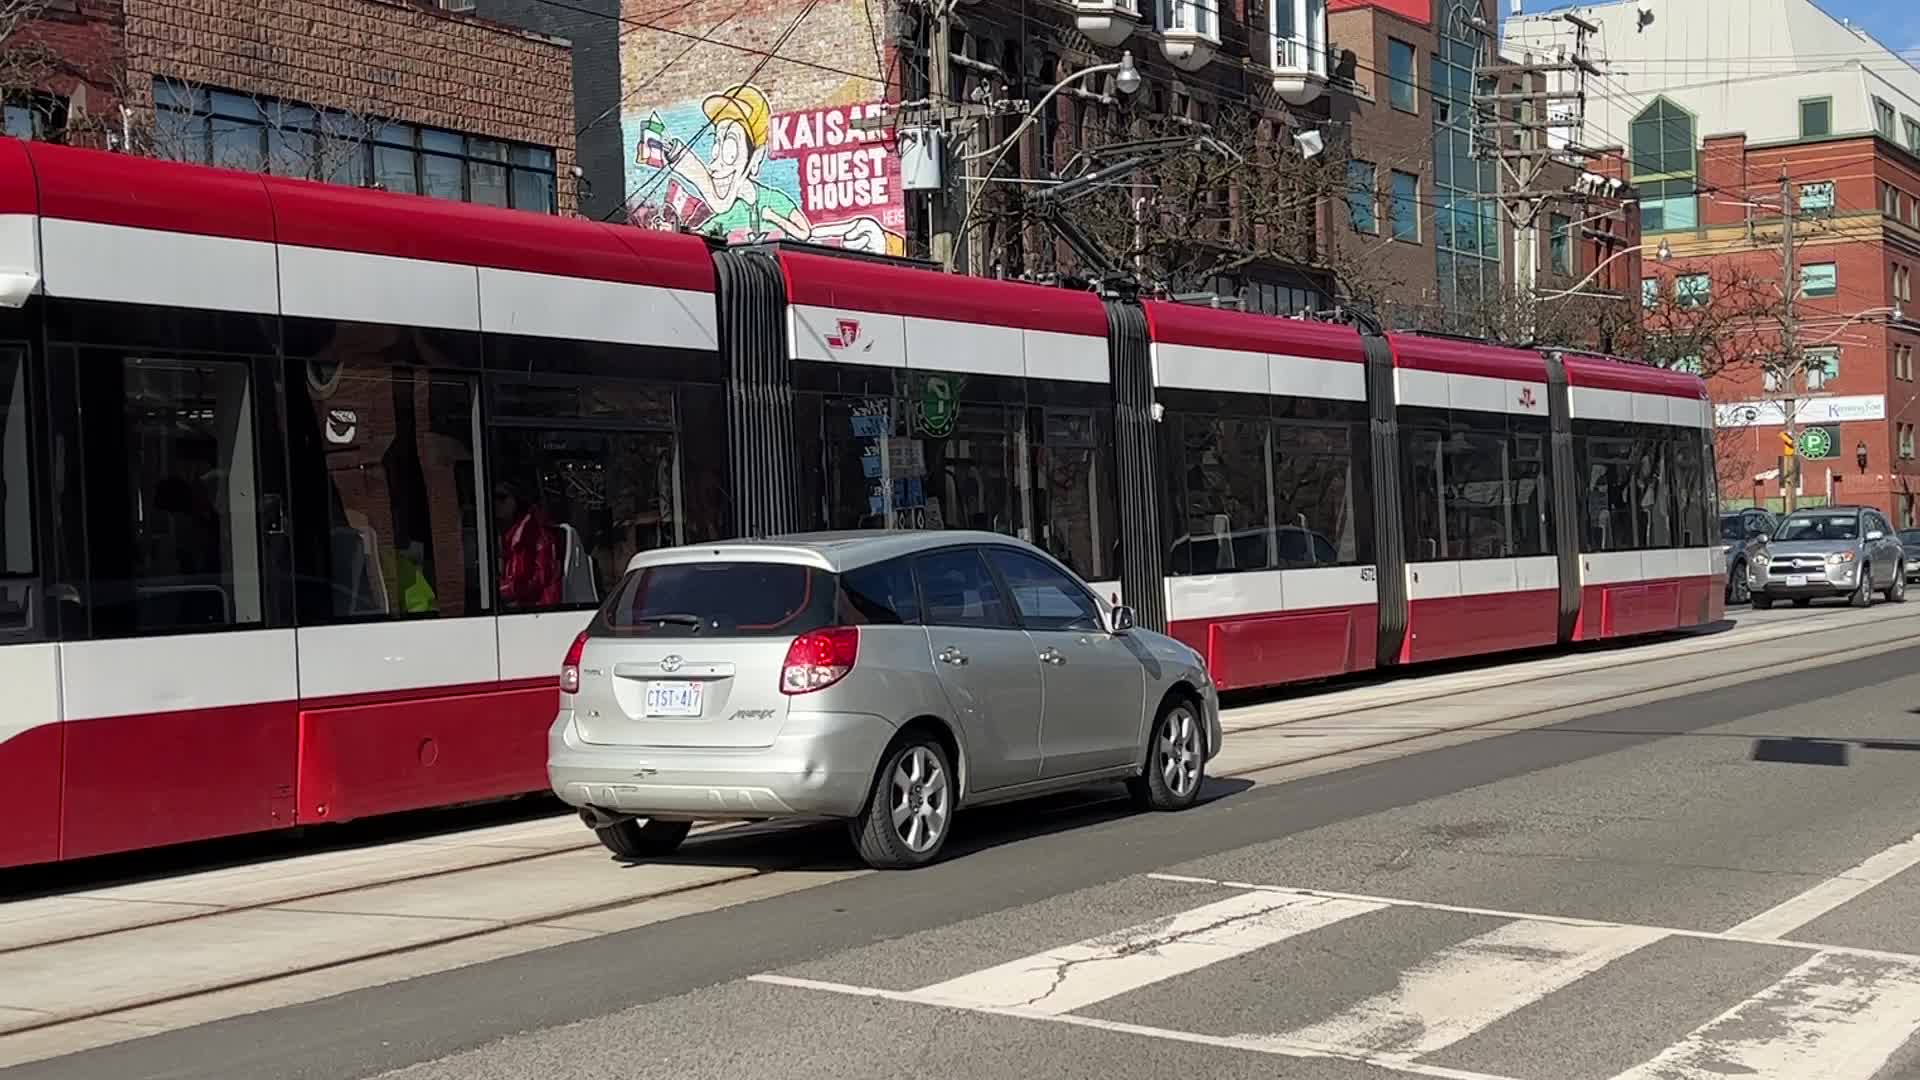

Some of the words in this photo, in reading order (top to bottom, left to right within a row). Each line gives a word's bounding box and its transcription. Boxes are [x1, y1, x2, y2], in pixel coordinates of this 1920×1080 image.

[806, 147, 888, 185] GUEST
[807, 177, 889, 210] HOUSE
[1807, 435, 1821, 448] P
